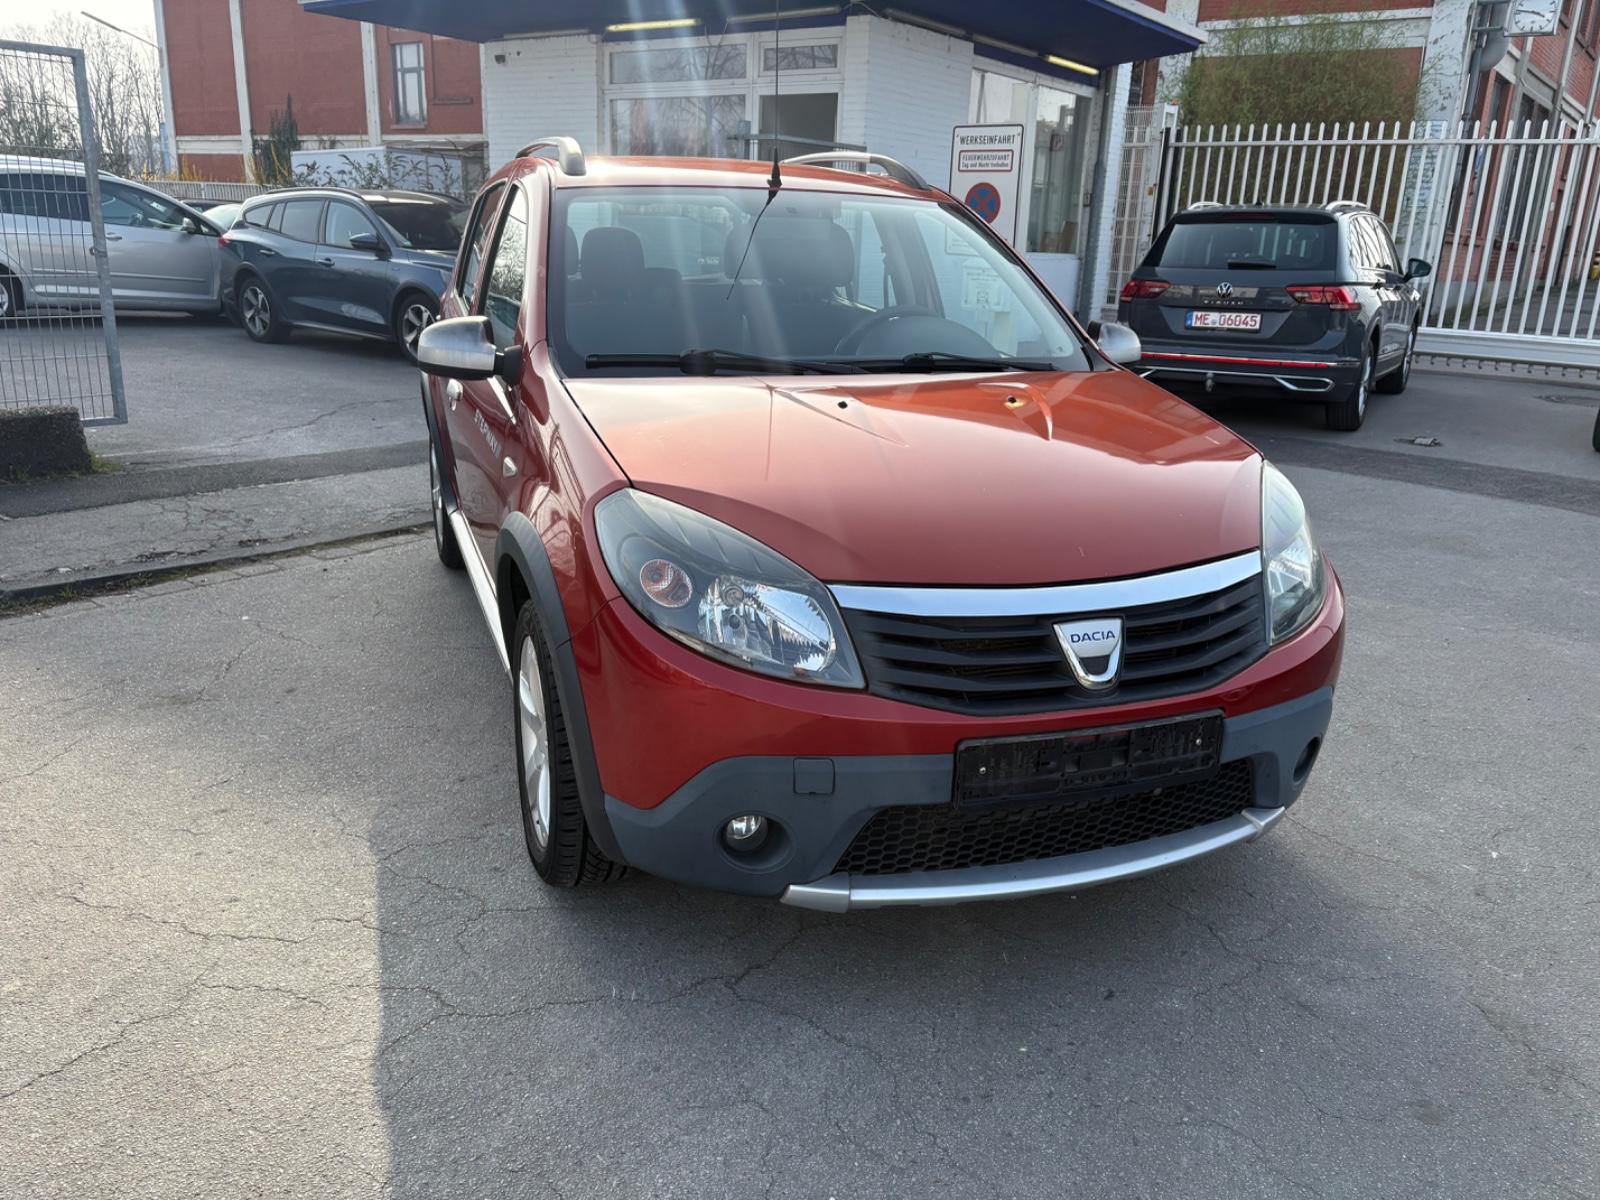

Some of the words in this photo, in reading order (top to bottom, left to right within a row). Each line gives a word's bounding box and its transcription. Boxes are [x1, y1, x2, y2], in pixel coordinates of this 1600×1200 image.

[960, 134, 1015, 145] WERKSEINFAHRT
[1194, 313, 1210, 326] ME
[1218, 314, 1257, 327] 06045
[1070, 630, 1116, 644] DACIA
